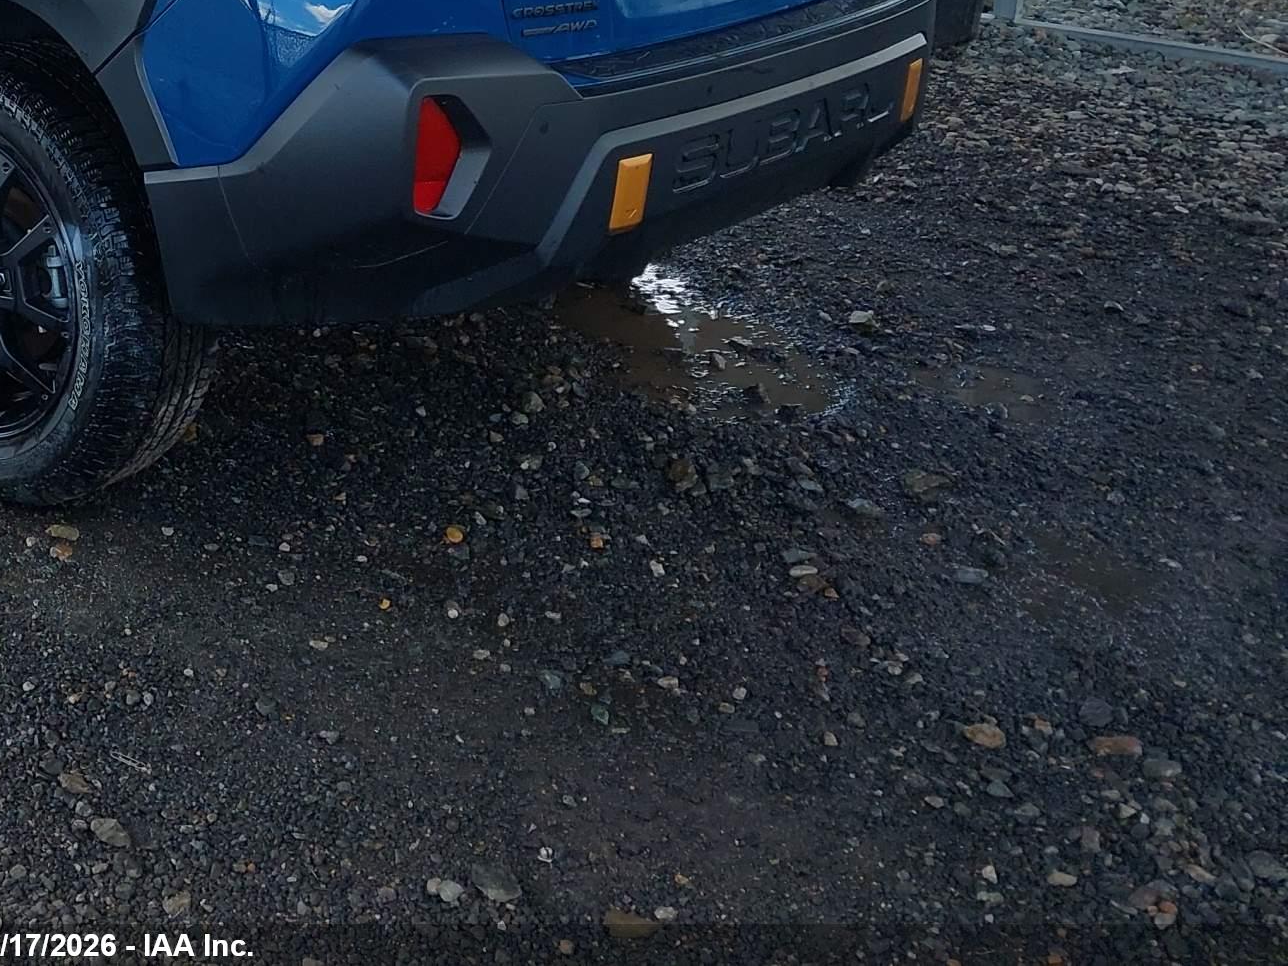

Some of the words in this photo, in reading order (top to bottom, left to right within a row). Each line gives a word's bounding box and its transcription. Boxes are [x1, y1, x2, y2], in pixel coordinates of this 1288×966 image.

[552, 19, 598, 34] AWD
[672, 82, 896, 194] SUBARU
[68, 260, 92, 411] YOKOHAMA
